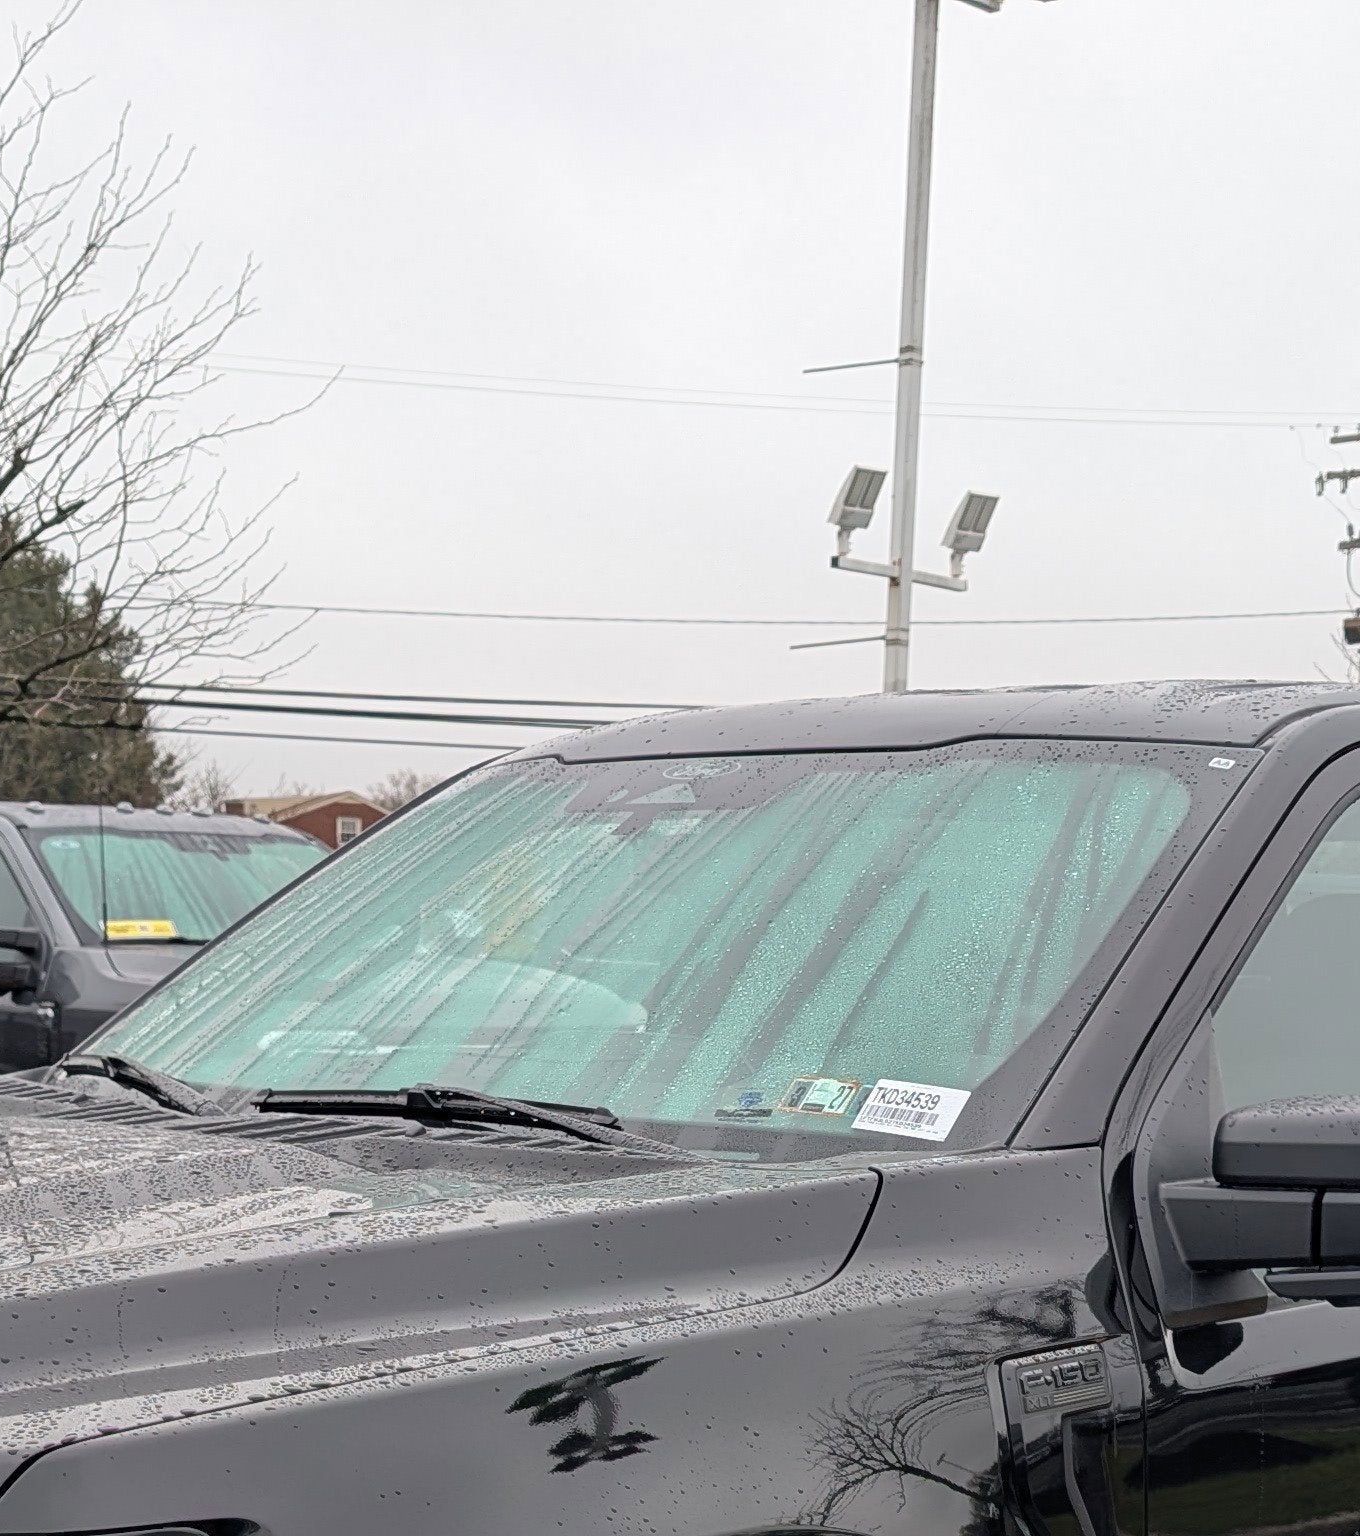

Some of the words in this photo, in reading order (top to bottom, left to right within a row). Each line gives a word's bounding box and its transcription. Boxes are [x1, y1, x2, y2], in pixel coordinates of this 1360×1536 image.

[828, 1085, 854, 1112] 27
[873, 1086, 941, 1111] TKD34539
[1019, 1359, 1102, 1396] F-150
